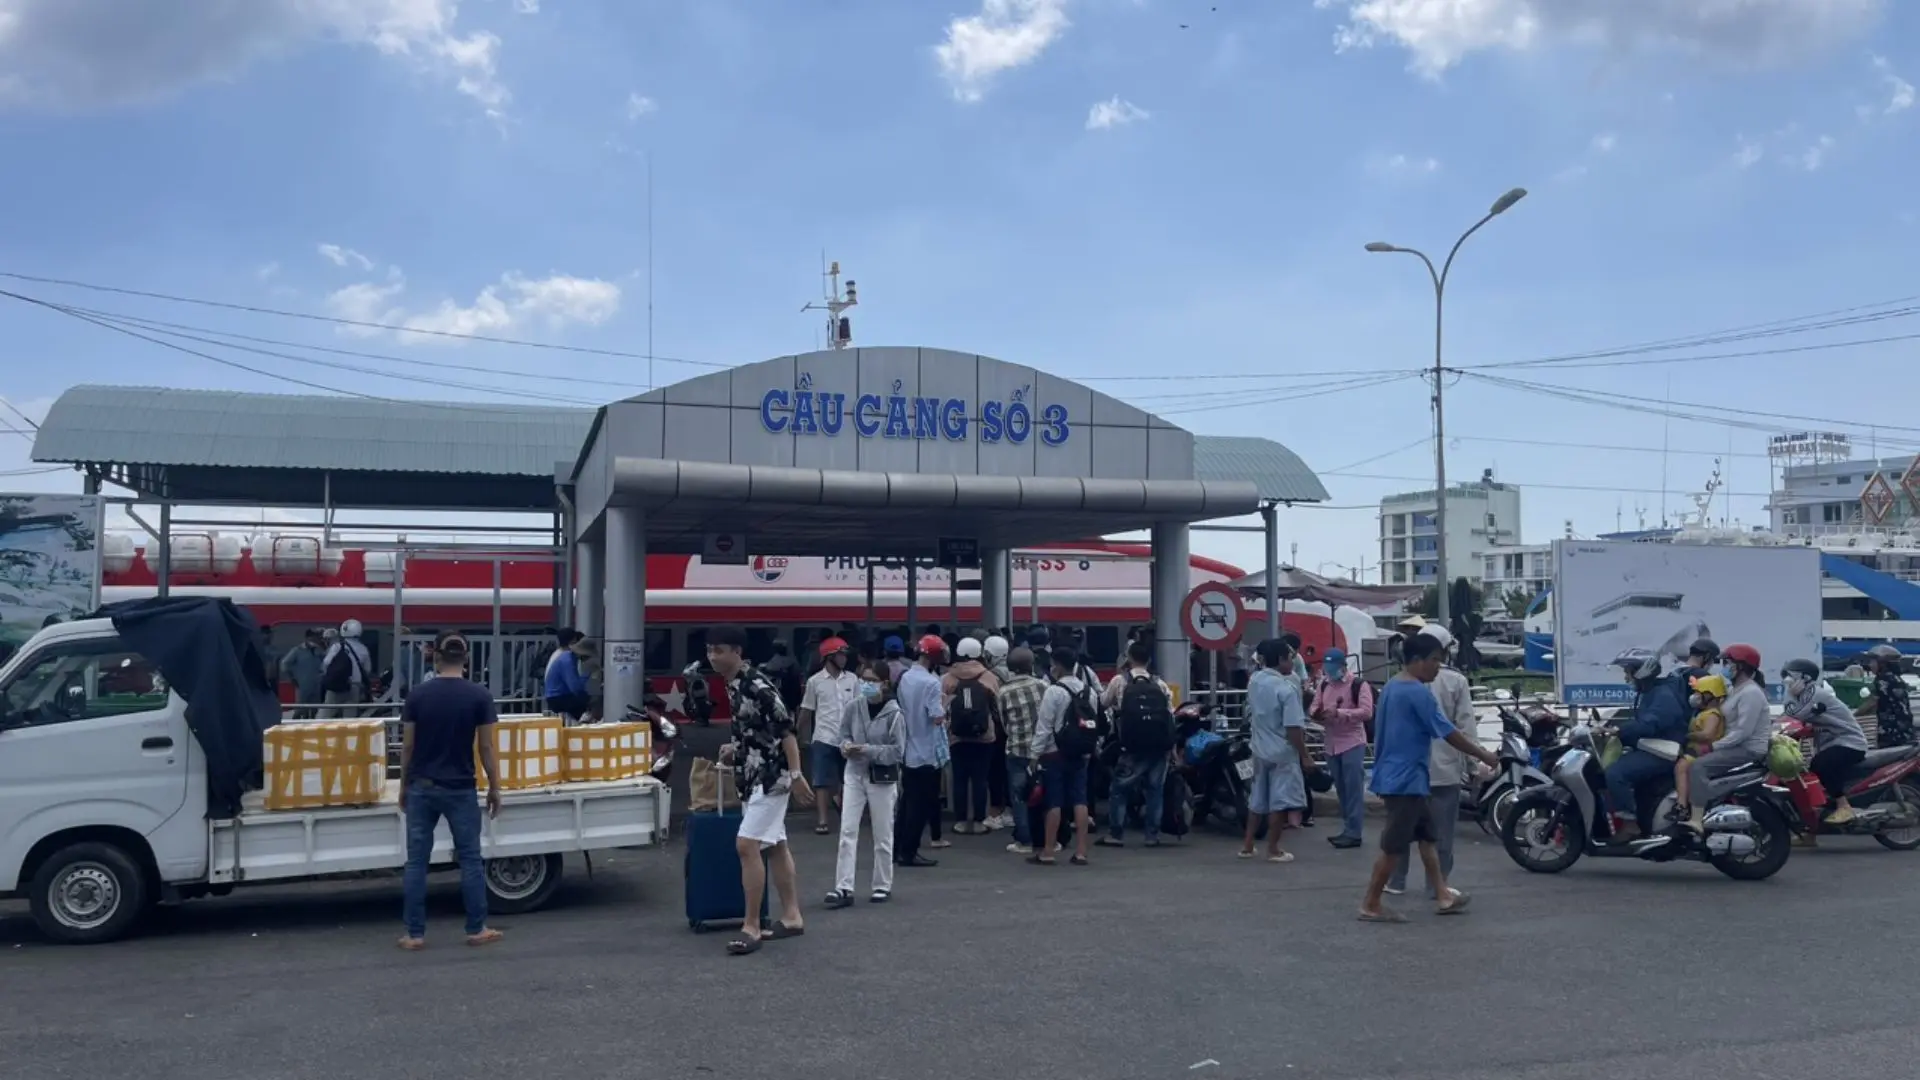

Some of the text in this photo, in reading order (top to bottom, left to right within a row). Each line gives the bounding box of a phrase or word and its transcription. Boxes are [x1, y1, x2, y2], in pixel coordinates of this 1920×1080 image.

[761, 372, 1071, 446] CẦU CẢNG SỐ 3
[1605, 689, 1624, 698] CAO
